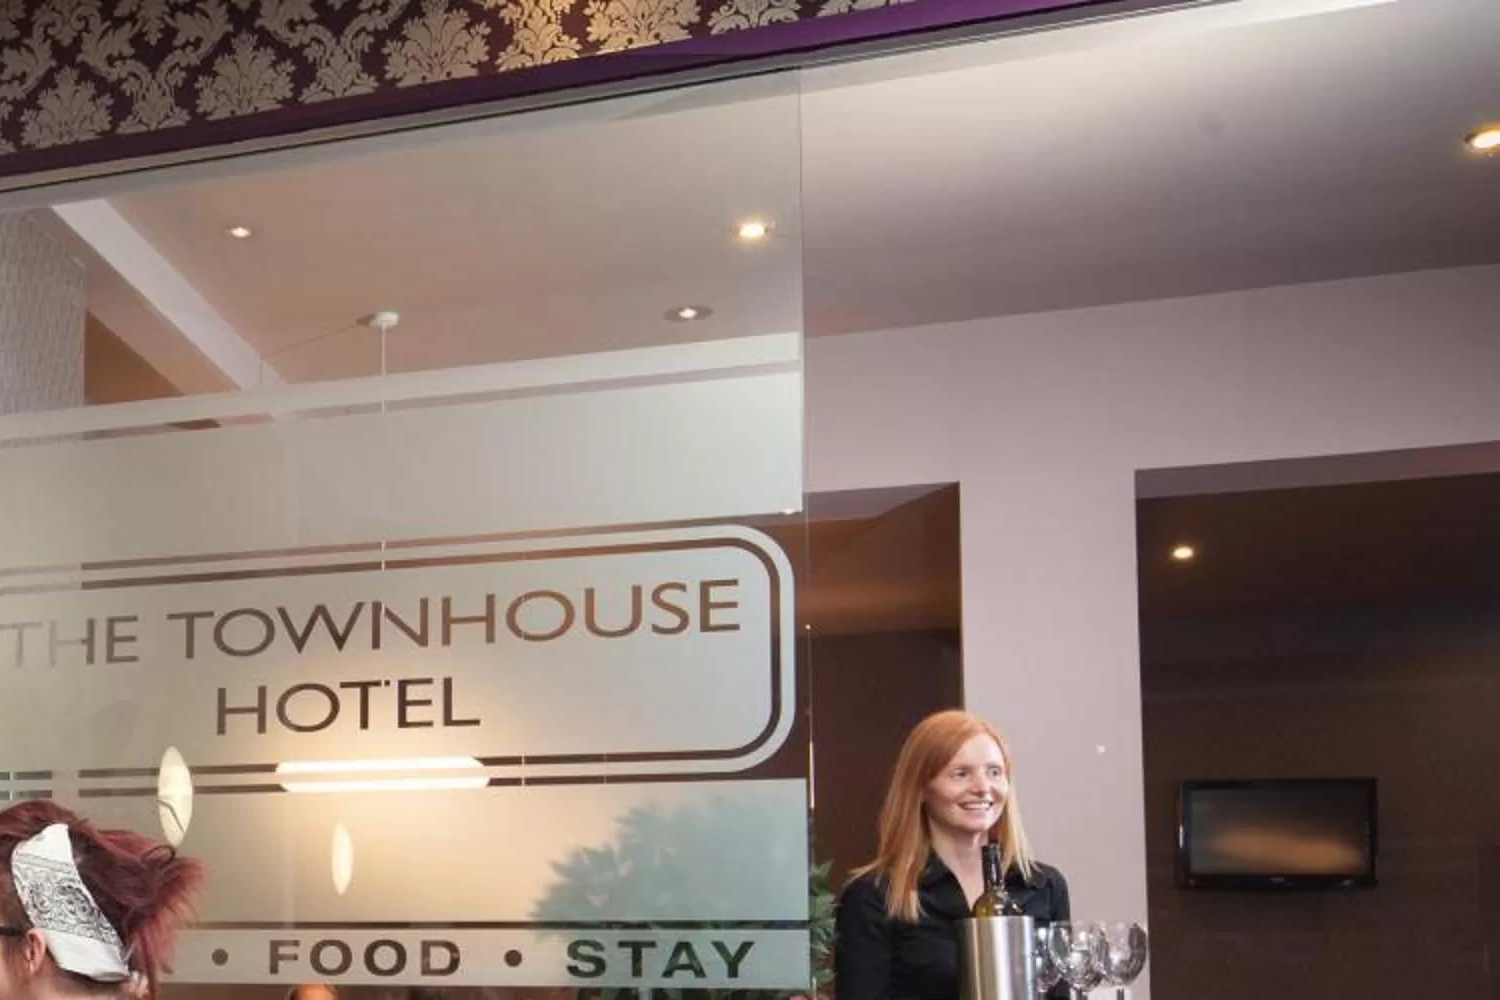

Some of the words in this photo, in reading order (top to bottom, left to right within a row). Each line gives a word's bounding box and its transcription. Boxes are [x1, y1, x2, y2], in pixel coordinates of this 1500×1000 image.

[166, 579, 741, 660] TOWNHOUSE
[216, 676, 481, 736] HOTEL
[268, 939, 462, 977] FOOD
[565, 940, 757, 979] STAY
